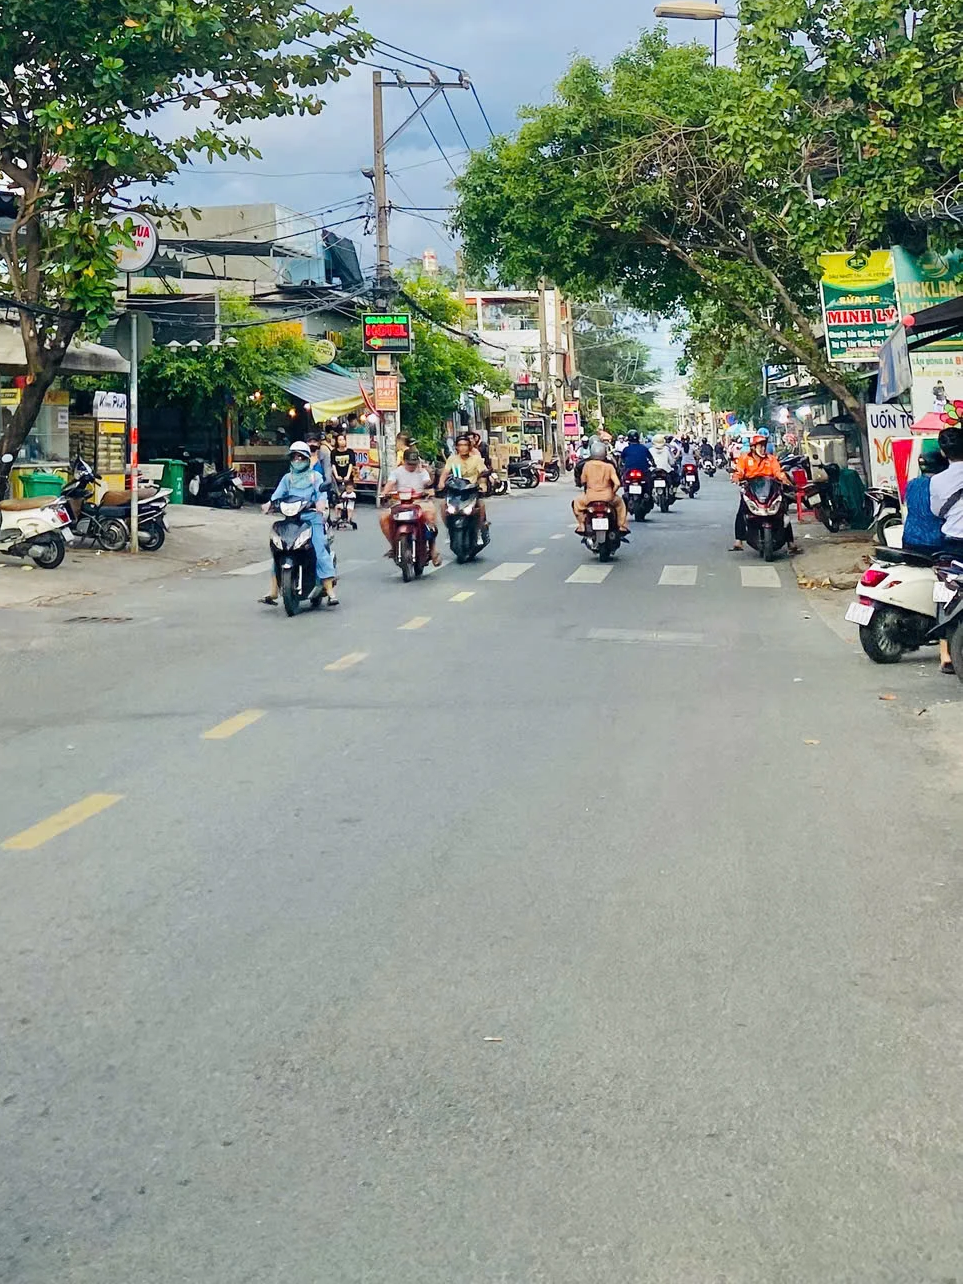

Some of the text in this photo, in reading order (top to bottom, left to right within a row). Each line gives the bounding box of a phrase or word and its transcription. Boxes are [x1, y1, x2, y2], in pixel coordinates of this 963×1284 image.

[827, 309, 872, 325] MINH
[365, 324, 408, 336] HOTEL
[870, 409, 896, 428] UỐN
